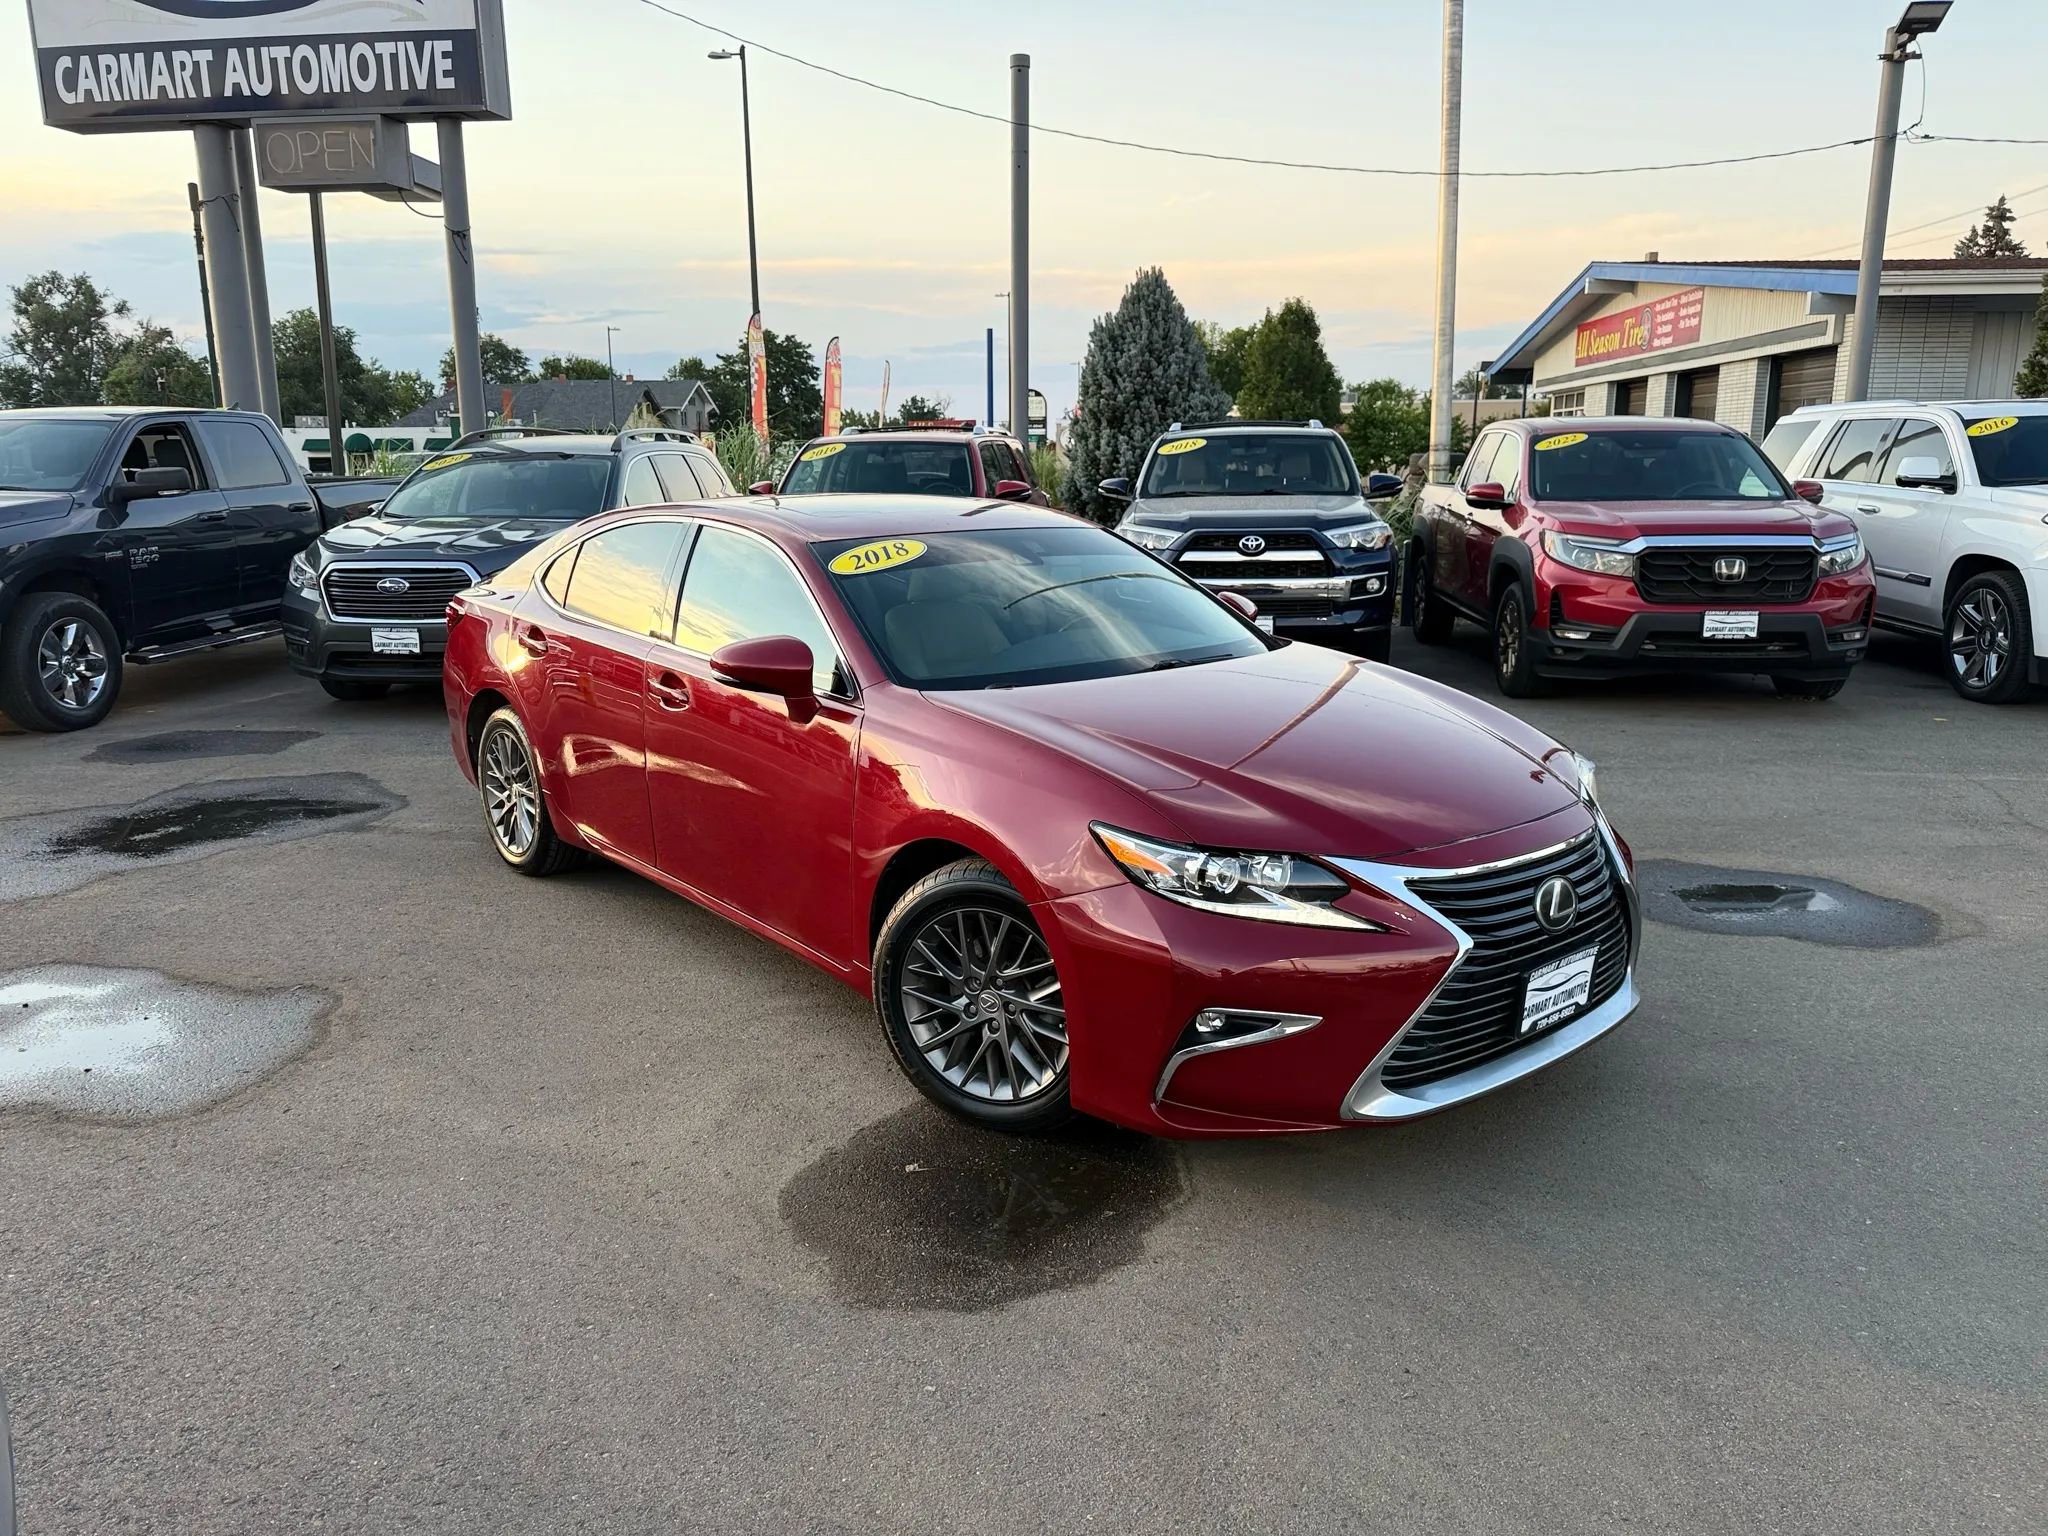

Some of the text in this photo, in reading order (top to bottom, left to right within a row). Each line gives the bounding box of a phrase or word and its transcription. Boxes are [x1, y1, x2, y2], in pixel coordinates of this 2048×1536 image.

[54, 40, 456, 104] CARMART AUTOMOTIVE
[266, 130, 375, 173] OPEN
[1576, 330, 1590, 358] All
[1589, 329, 1620, 356] Season
[1622, 317, 1644, 348] Tire
[1545, 435, 1577, 448] 2022
[1976, 419, 2008, 433] 2016
[808, 447, 837, 459] 2016
[1167, 440, 1198, 452] 2018
[849, 542, 909, 570] 2018
[1530, 945, 1600, 982] CARMART AUTOMOTIVE
[1523, 981, 1588, 1019] CARMART AUTOMOTIVE
